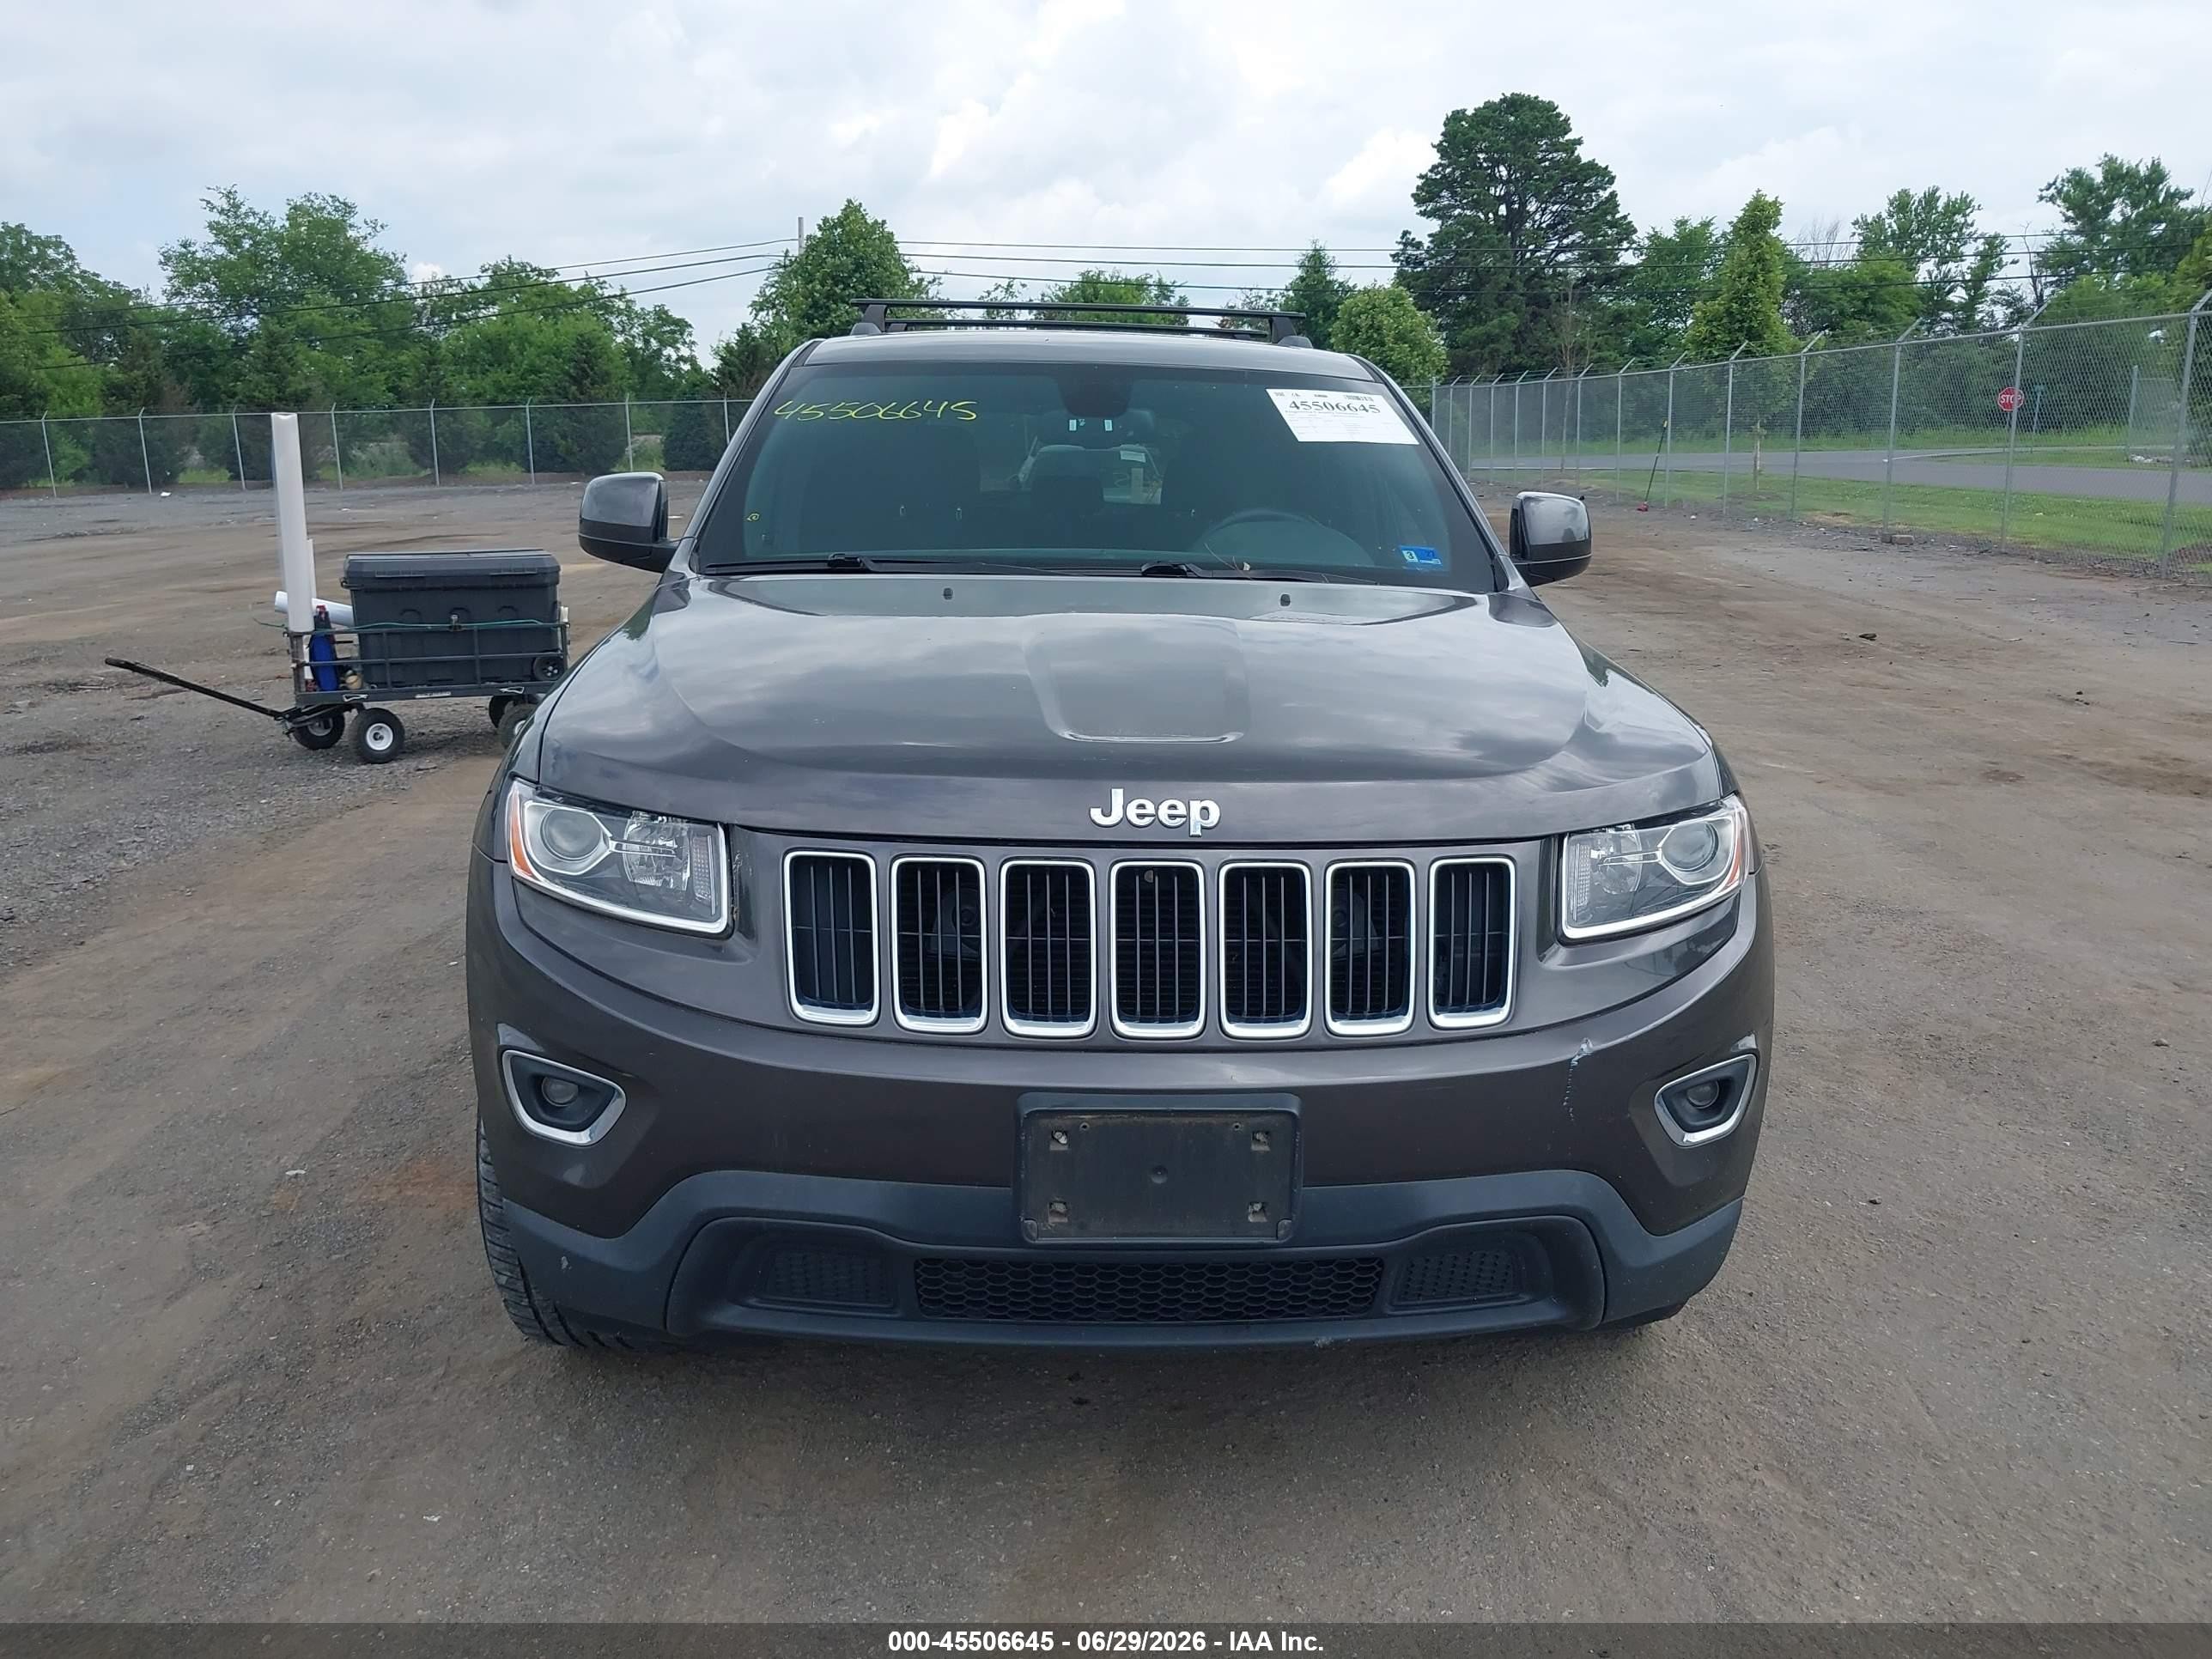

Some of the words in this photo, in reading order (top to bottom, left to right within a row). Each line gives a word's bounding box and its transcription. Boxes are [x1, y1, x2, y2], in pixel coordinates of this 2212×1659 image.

[775, 400, 978, 421] 45506645
[1289, 400, 1381, 414] 45506645
[1407, 551, 1414, 560] 3
[1089, 787, 1221, 837] Jeep
